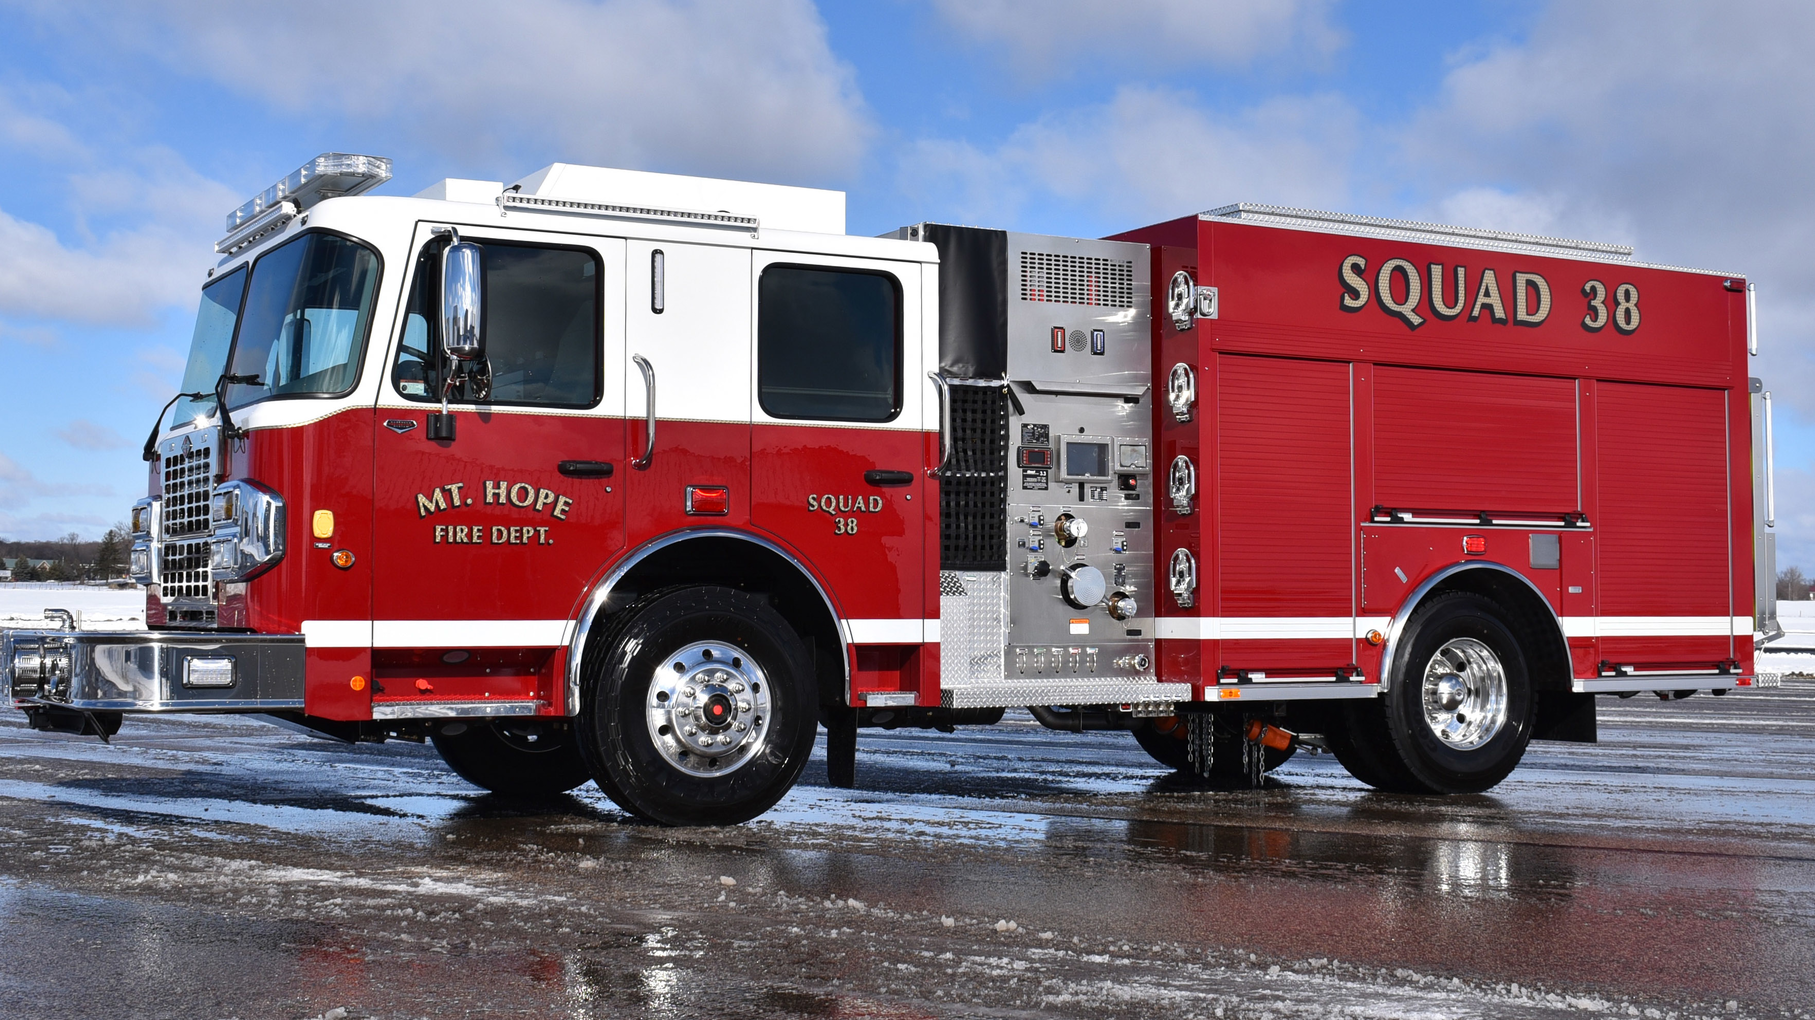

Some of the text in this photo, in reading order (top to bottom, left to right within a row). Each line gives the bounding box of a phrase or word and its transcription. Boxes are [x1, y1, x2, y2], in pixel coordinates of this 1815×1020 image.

[1339, 254, 1641, 335] SQUAD 38
[416, 480, 573, 520] MT. HOPE
[807, 494, 883, 516] SQUAD
[434, 525, 554, 545] FIRE DEPT.
[834, 517, 858, 535] 38
